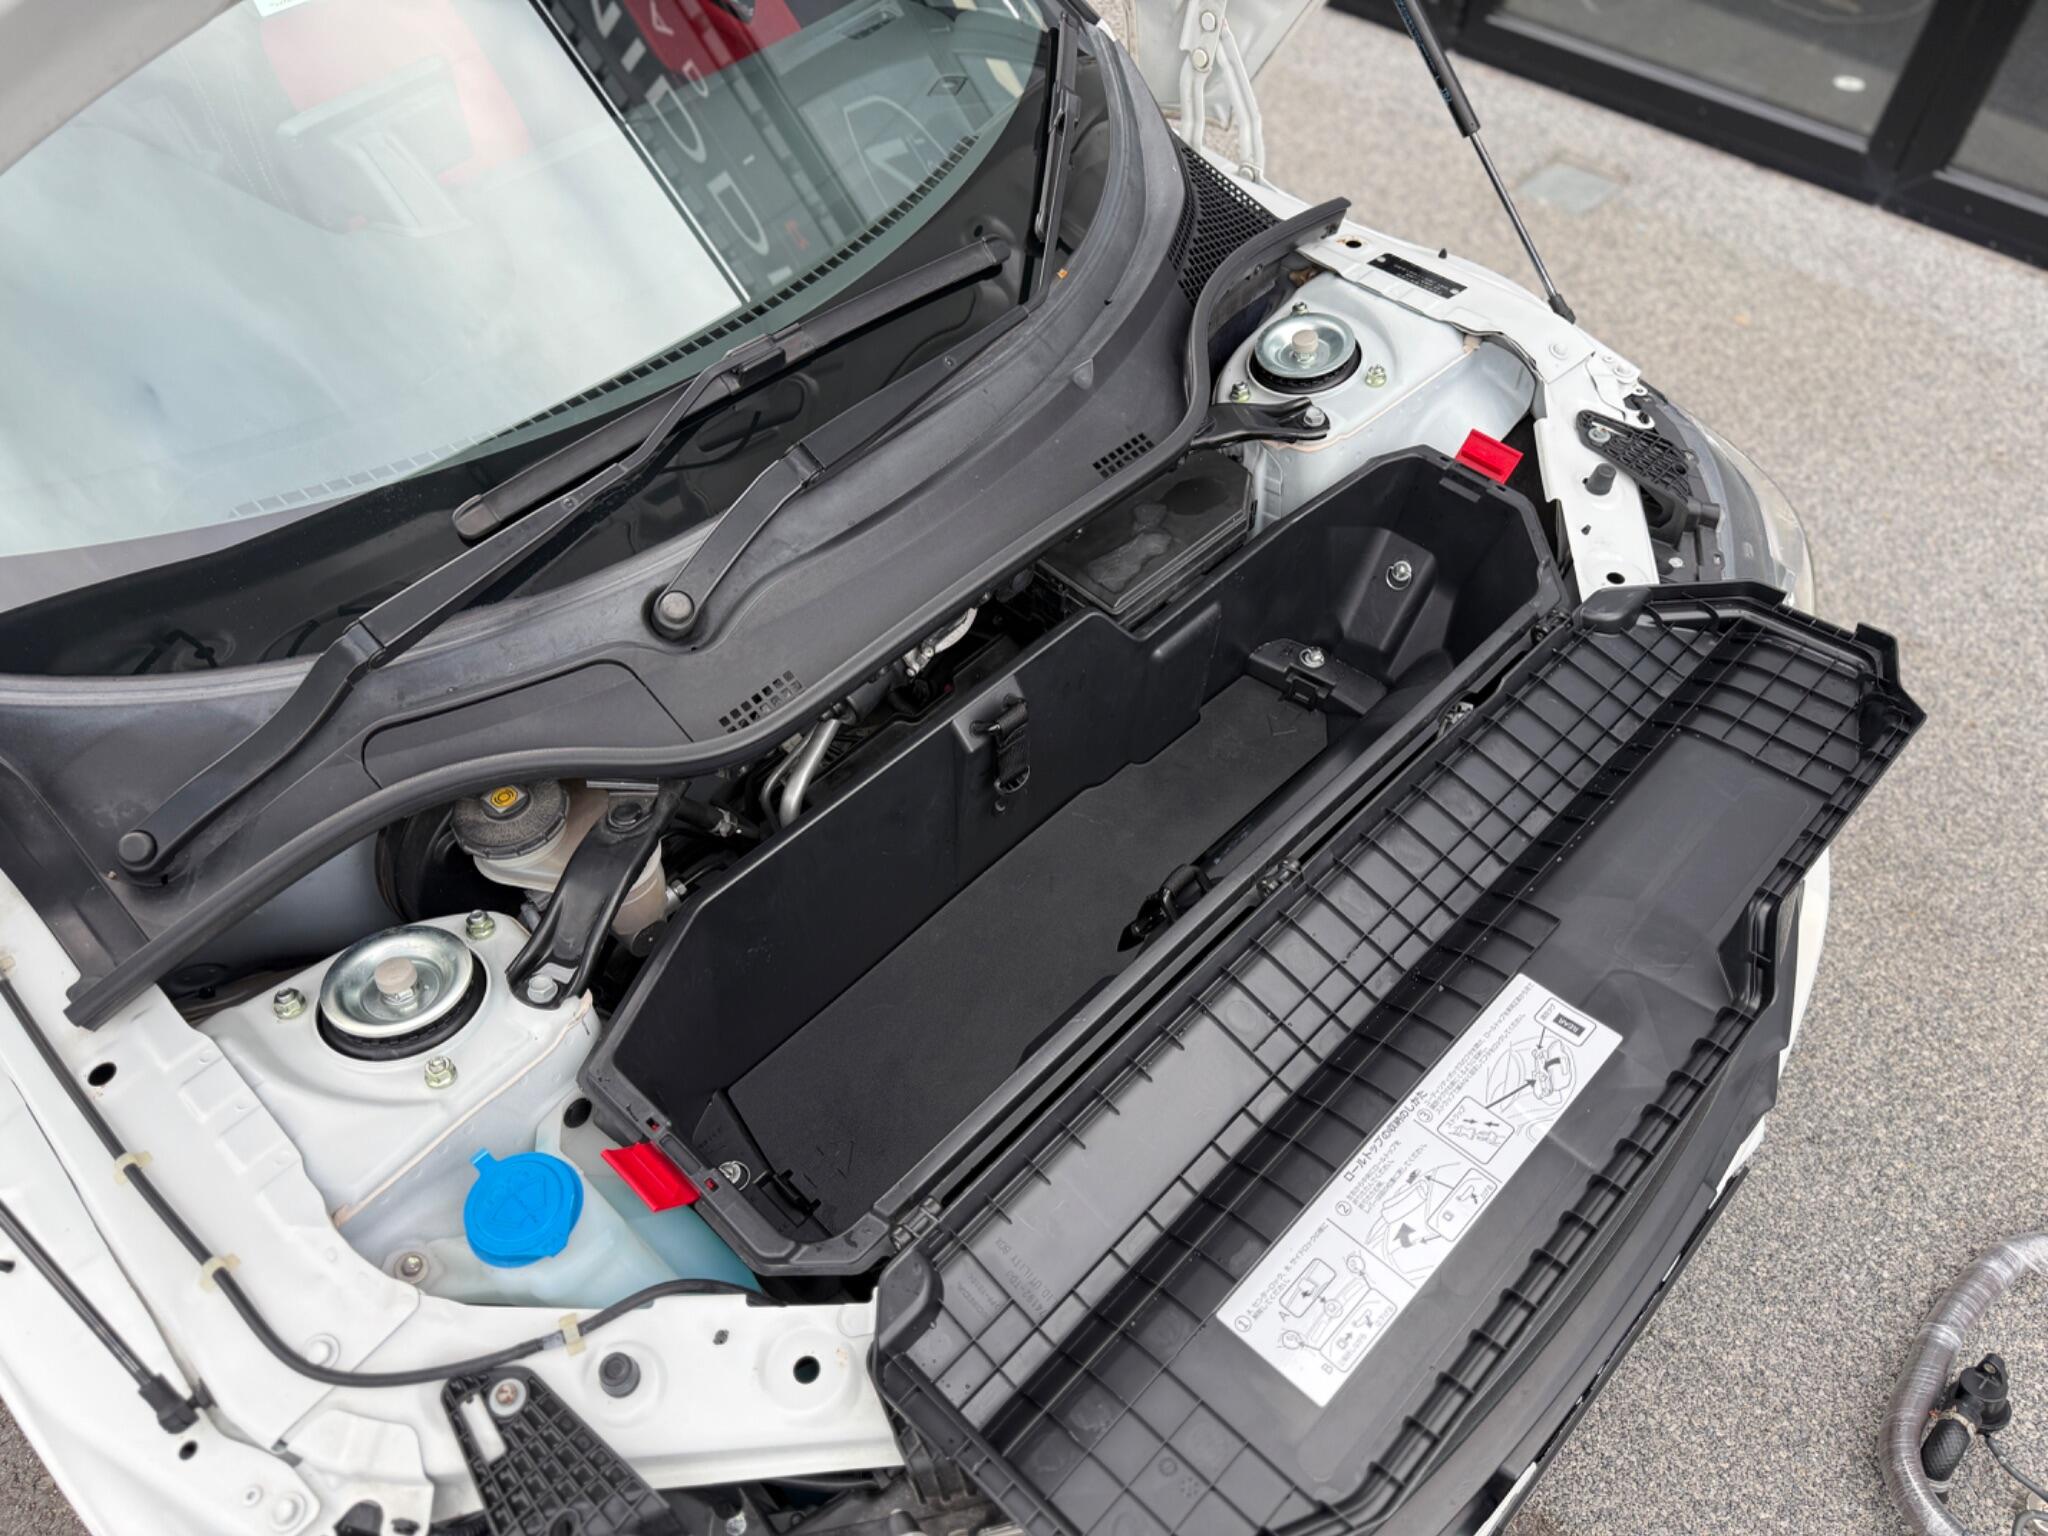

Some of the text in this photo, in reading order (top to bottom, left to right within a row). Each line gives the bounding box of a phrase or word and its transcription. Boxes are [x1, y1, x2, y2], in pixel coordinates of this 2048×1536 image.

[1341, 1088, 1428, 1182] ロールトップの収納のしかた
[1276, 1308, 1290, 1322] A
[1320, 1361, 1334, 1376] B
